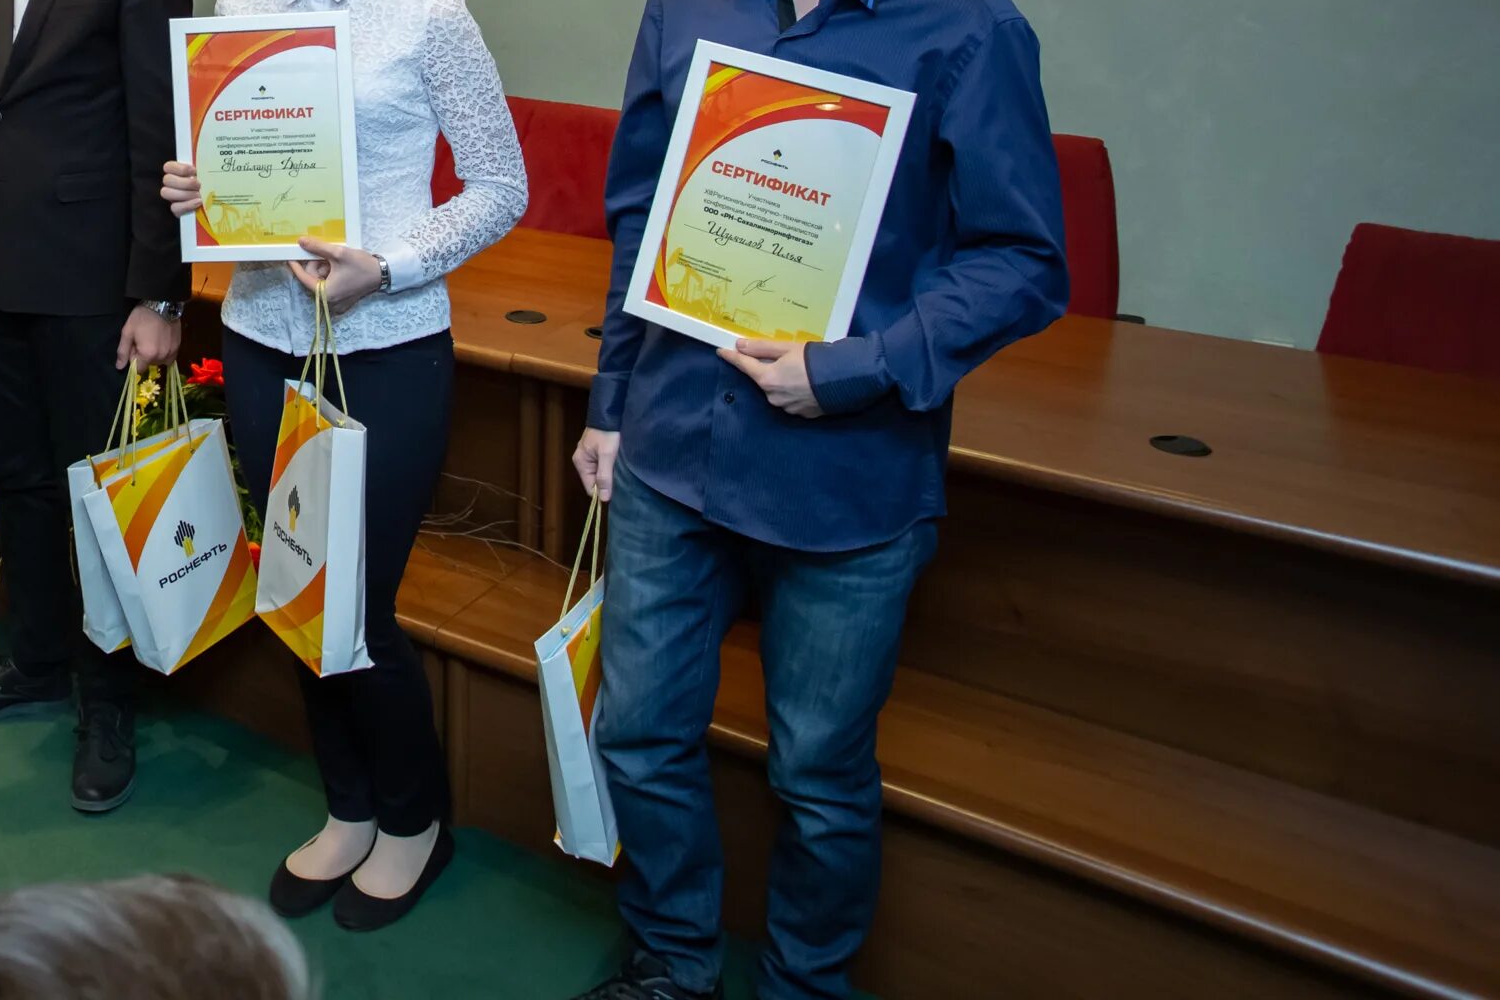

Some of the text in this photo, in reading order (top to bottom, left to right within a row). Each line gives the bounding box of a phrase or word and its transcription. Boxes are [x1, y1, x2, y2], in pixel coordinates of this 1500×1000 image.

[215, 107, 314, 121] СЕРТИФИКАТ
[712, 161, 831, 206] СЕРТИФИКАТ
[704, 206, 719, 216] ООО
[159, 542, 228, 589] РОСНЕФТЬ
[273, 521, 313, 567] РОСНЕФТЬ
